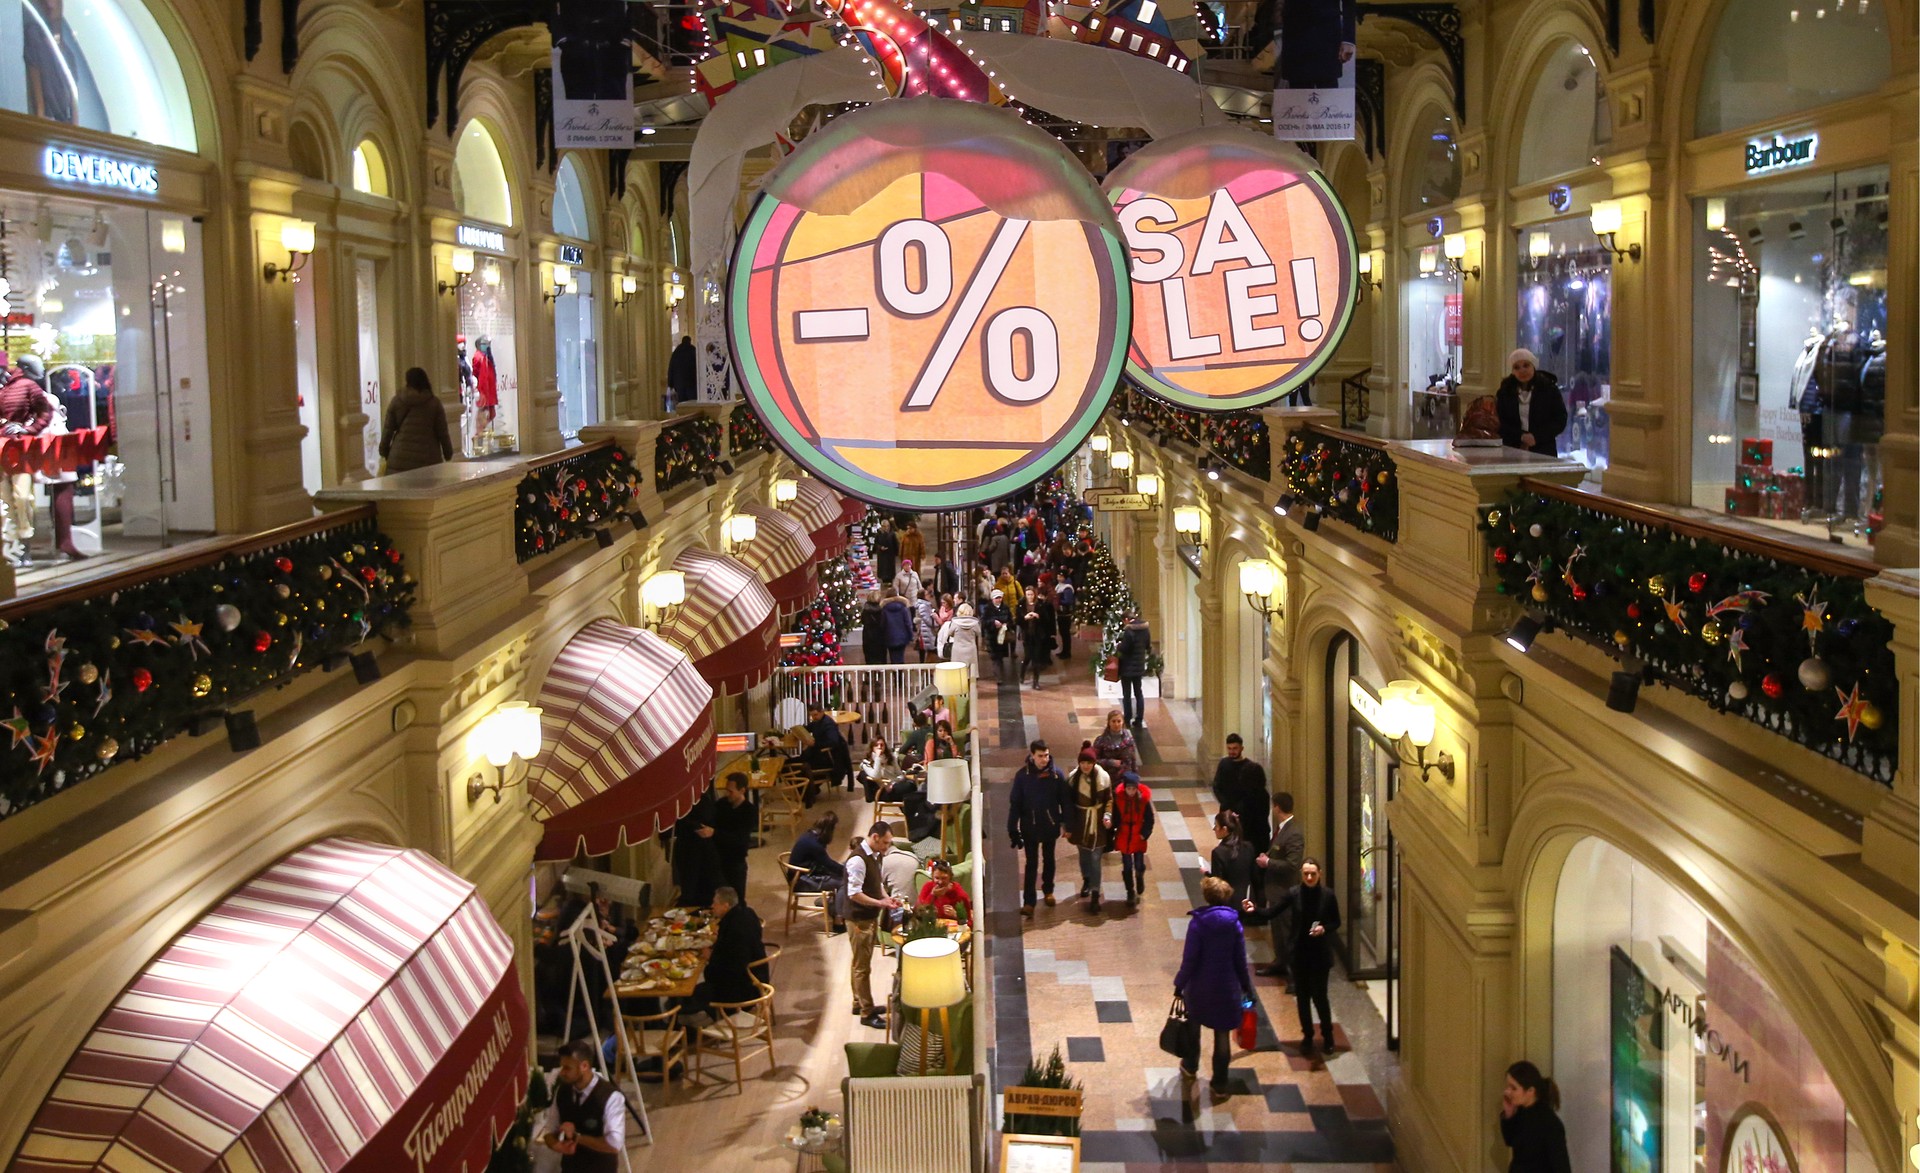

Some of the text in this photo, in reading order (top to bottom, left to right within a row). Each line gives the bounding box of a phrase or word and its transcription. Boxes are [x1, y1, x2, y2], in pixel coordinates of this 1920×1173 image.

[46, 149, 159, 193] DEVERNOIS
[1745, 137, 1814, 172] Barbour
[1160, 256, 1324, 361] LE!
[403, 1034, 500, 1173] Гастроном
